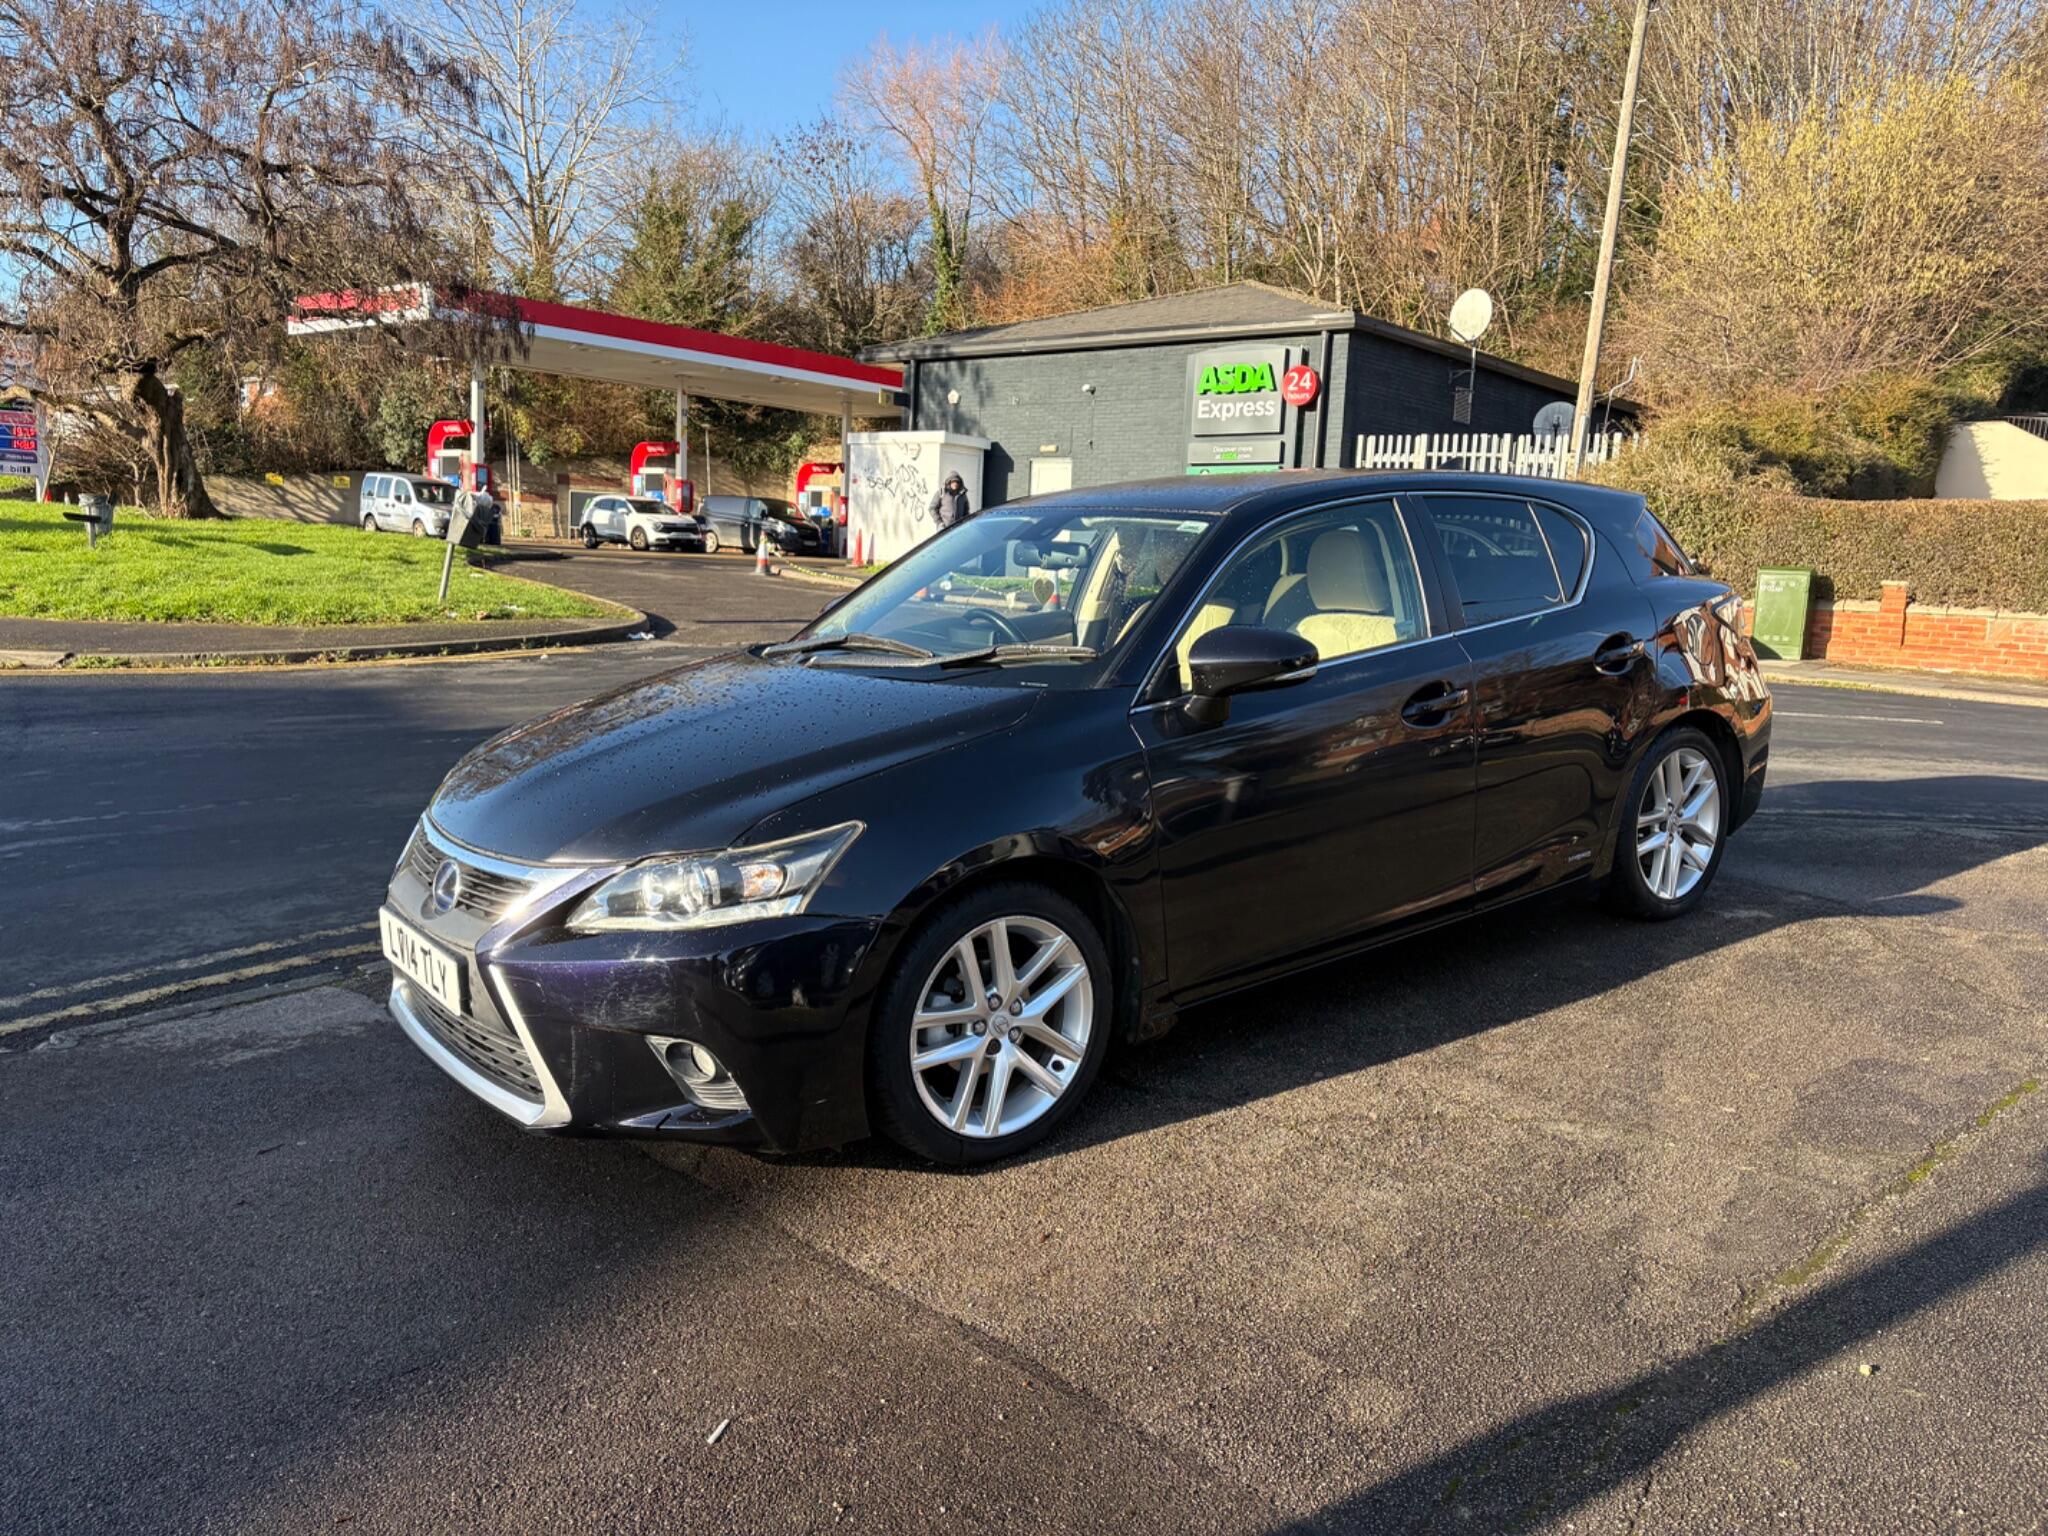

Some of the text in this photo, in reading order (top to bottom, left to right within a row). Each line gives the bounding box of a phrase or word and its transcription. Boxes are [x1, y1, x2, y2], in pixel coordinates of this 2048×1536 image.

[1197, 362, 1275, 395] ASDA
[1287, 371, 1312, 391] 24
[1287, 391, 1310, 400] hours
[1197, 399, 1275, 421] Express
[420, 945, 447, 1000] TLY
